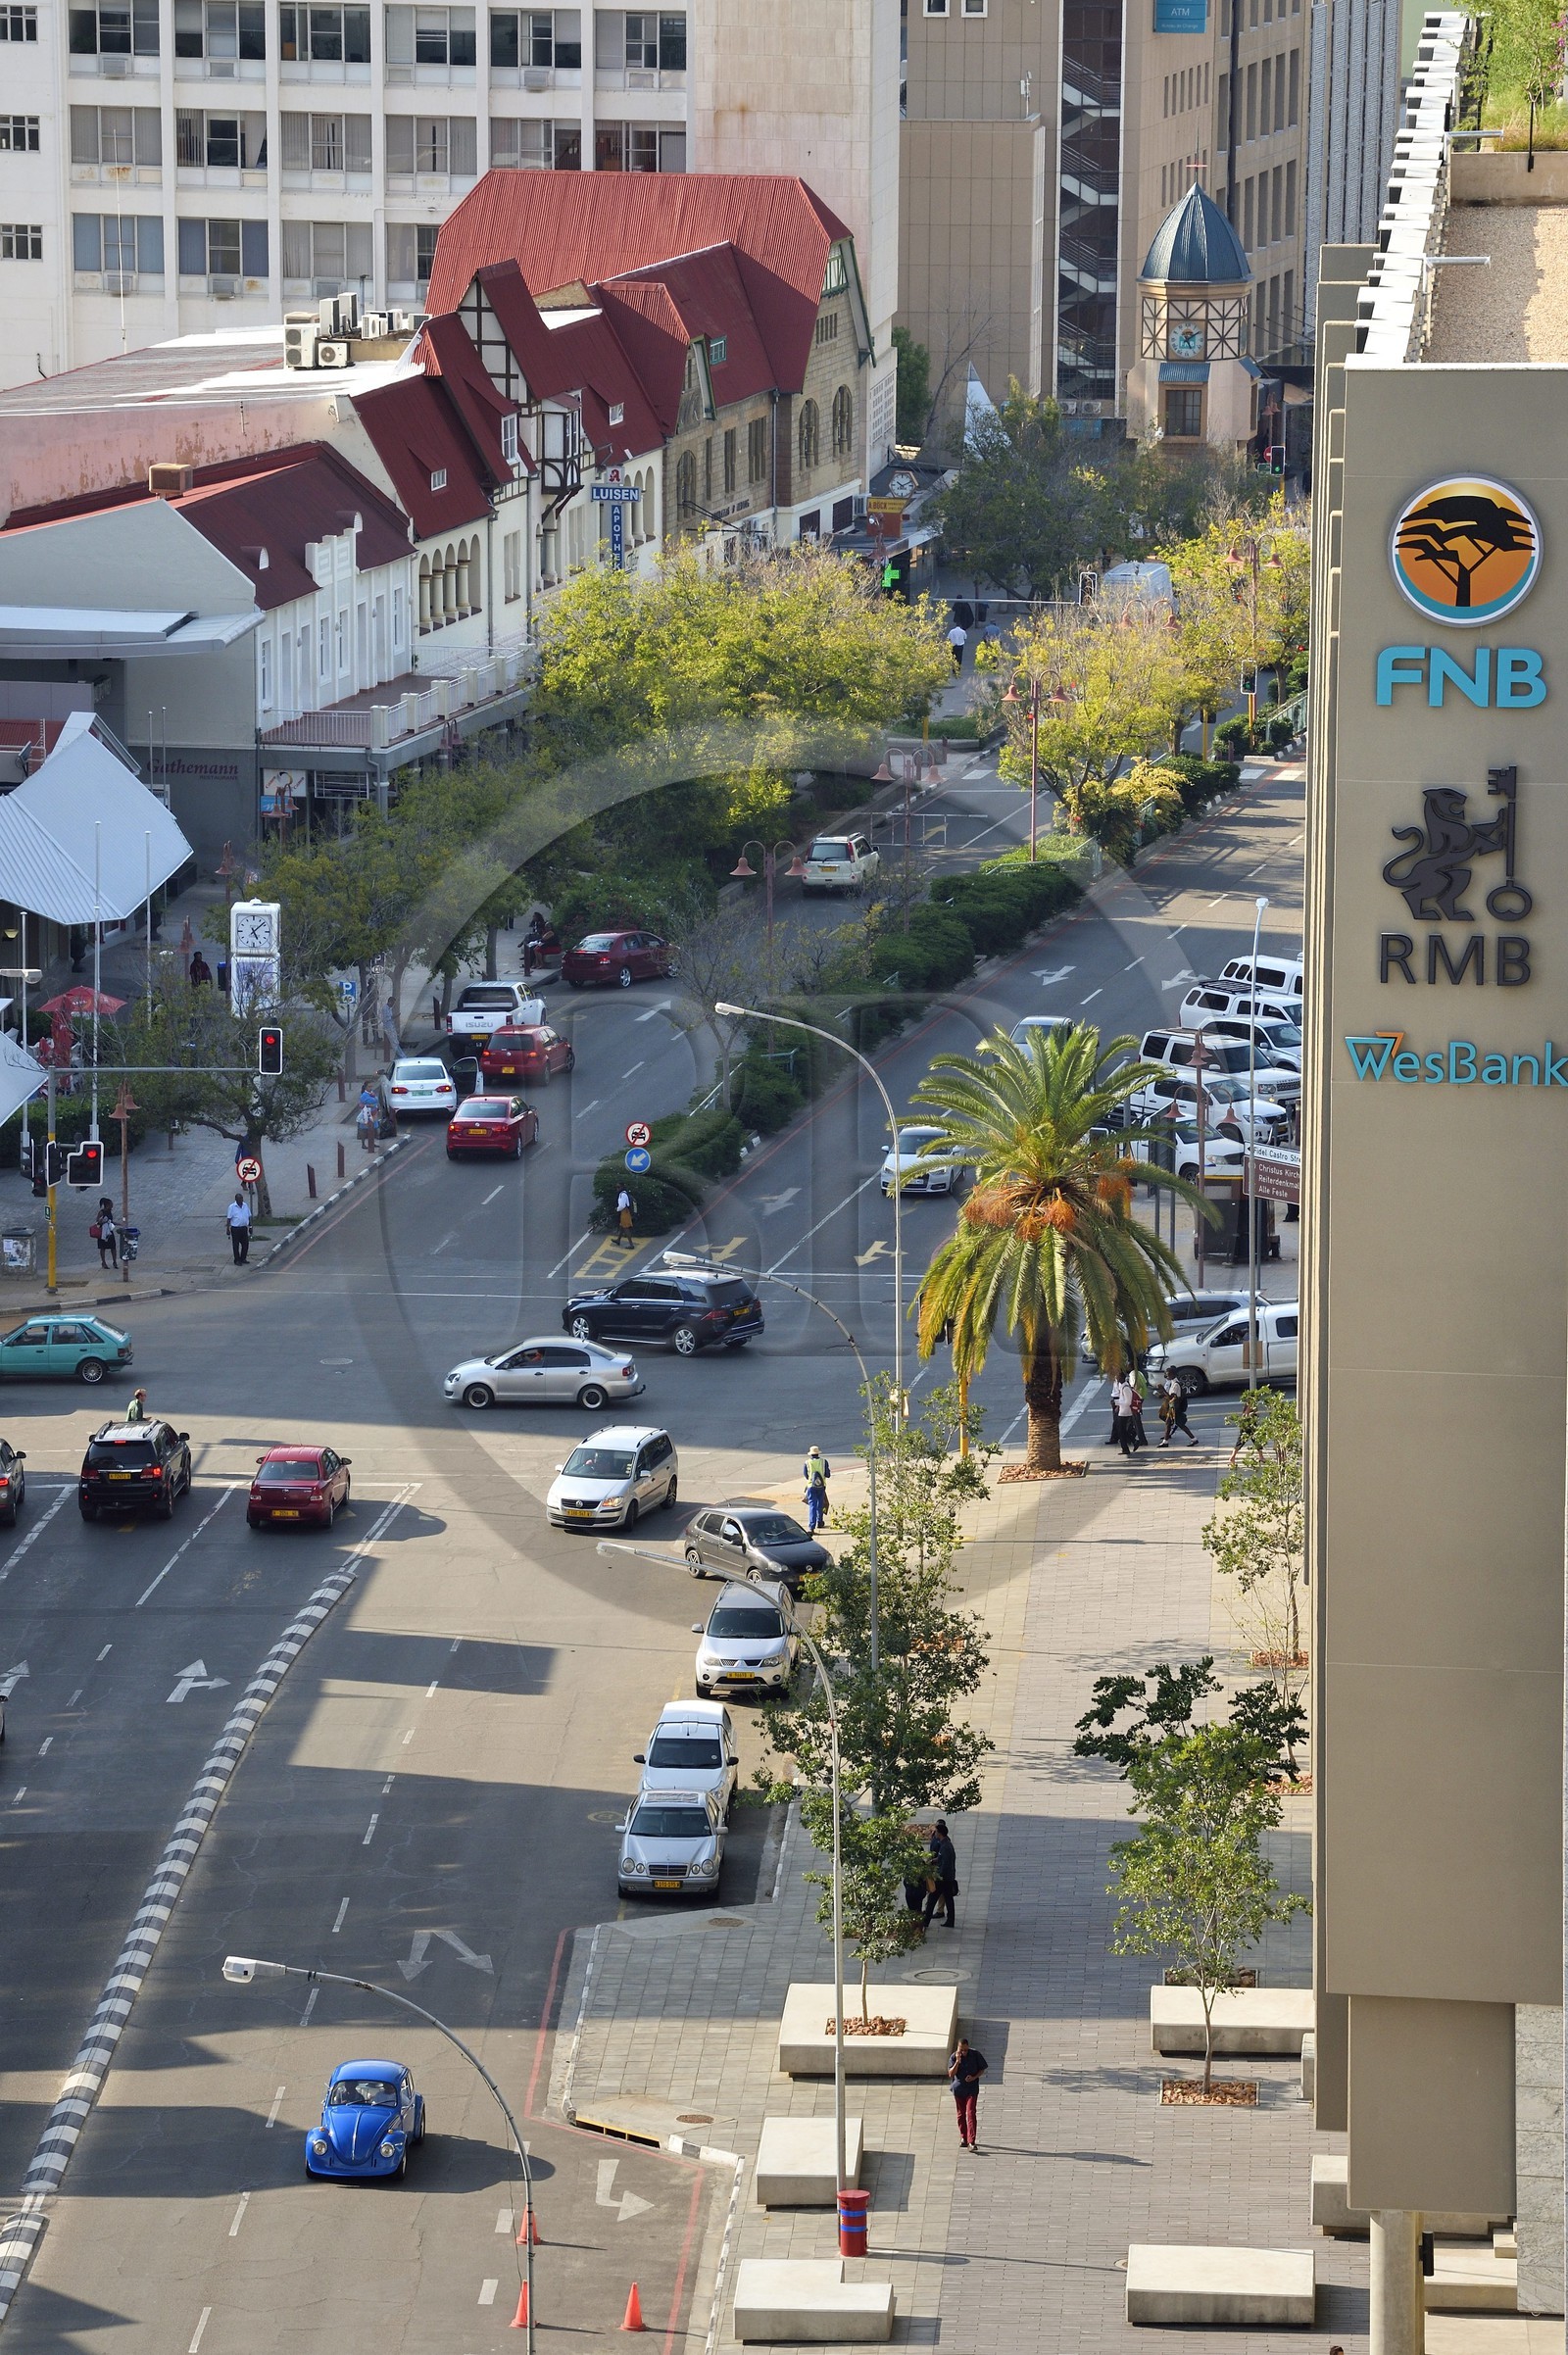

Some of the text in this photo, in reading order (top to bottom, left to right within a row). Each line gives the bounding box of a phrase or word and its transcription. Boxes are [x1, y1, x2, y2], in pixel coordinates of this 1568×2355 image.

[1170, 7, 1190, 16] ATM
[593, 488, 639, 500] LUISEN
[1376, 645, 1548, 709] FNB
[146, 759, 239, 775] Gathemann
[1380, 932, 1531, 987] RMB
[343, 982, 353, 995] P
[1345, 1034, 1568, 1087] WesBank
[1269, 1151, 1288, 1160] Castro
[1258, 1163, 1283, 1176] Christus
